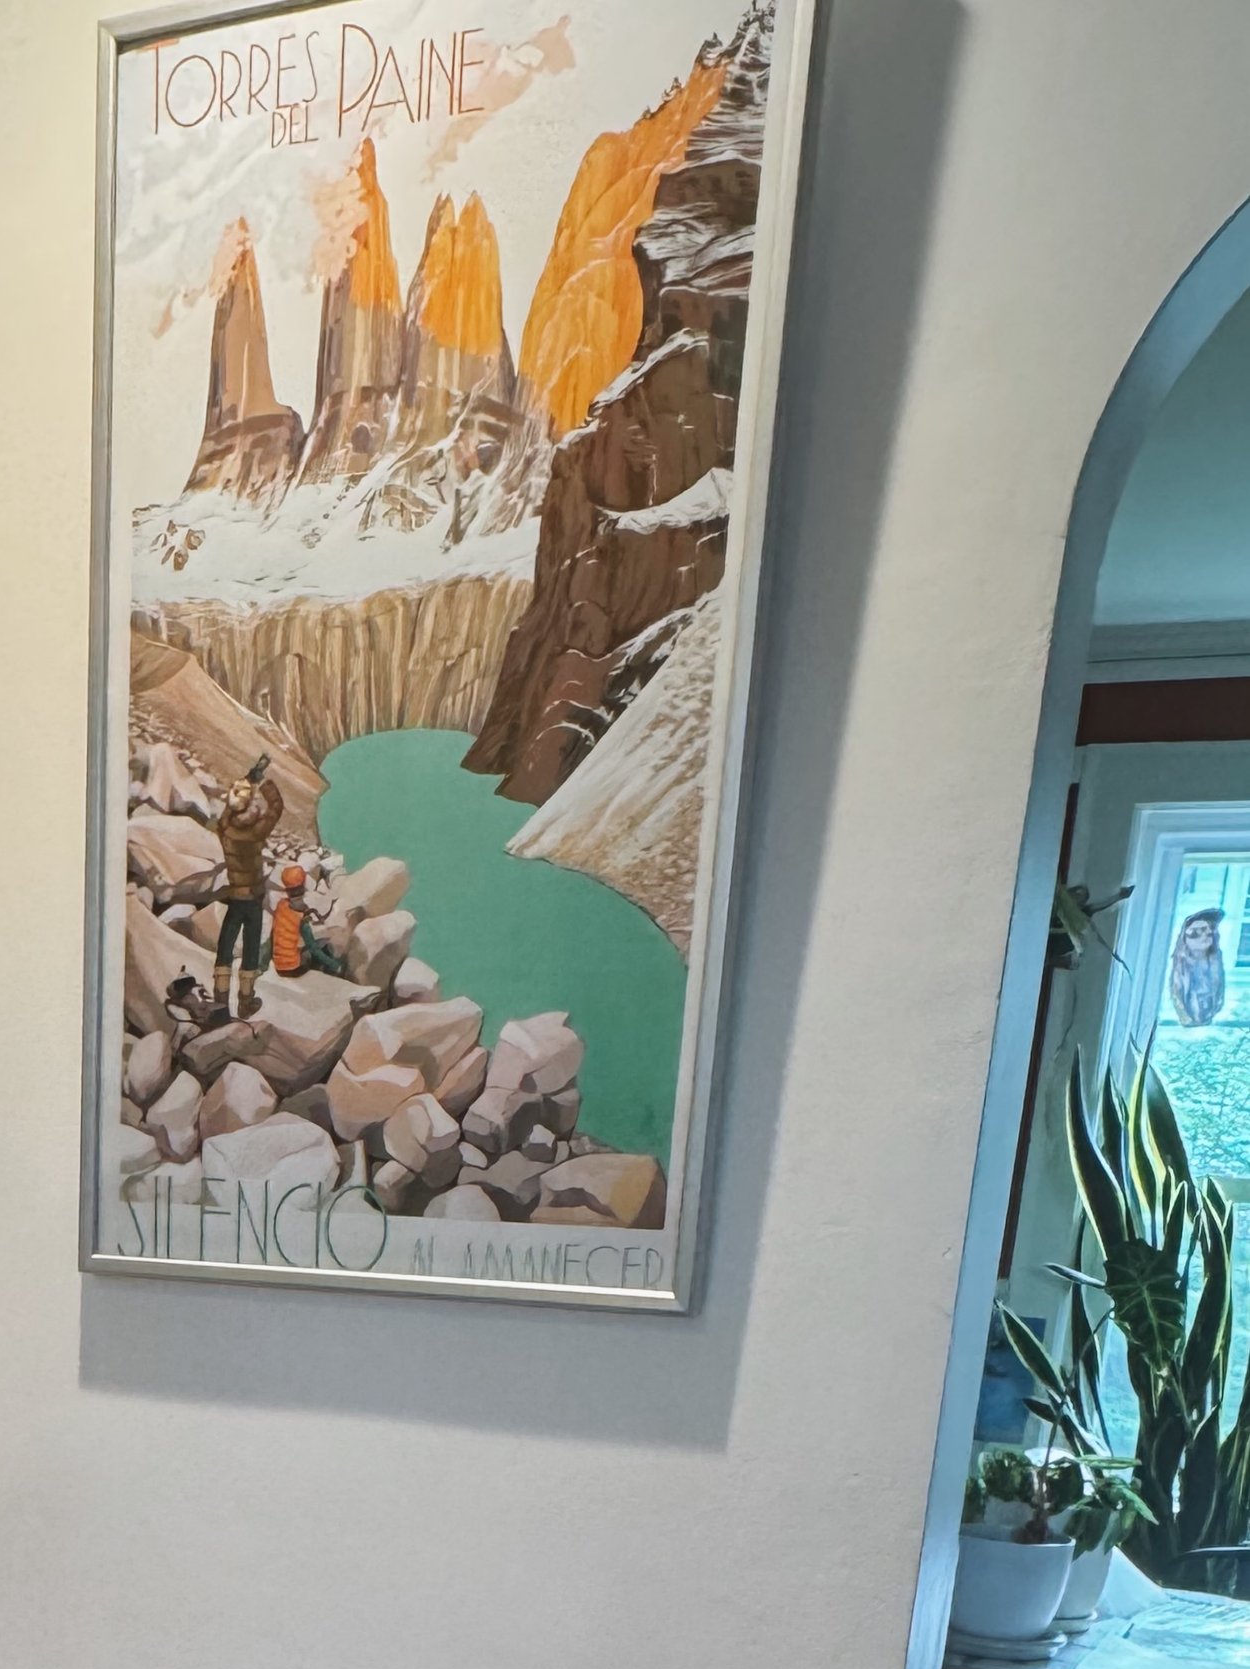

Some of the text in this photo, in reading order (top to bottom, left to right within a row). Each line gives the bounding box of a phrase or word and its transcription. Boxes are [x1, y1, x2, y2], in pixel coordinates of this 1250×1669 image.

[134, 23, 486, 139] TORRES PAINE
[270, 103, 320, 149] DEL
[116, 1175, 388, 1271] SILENCIO
